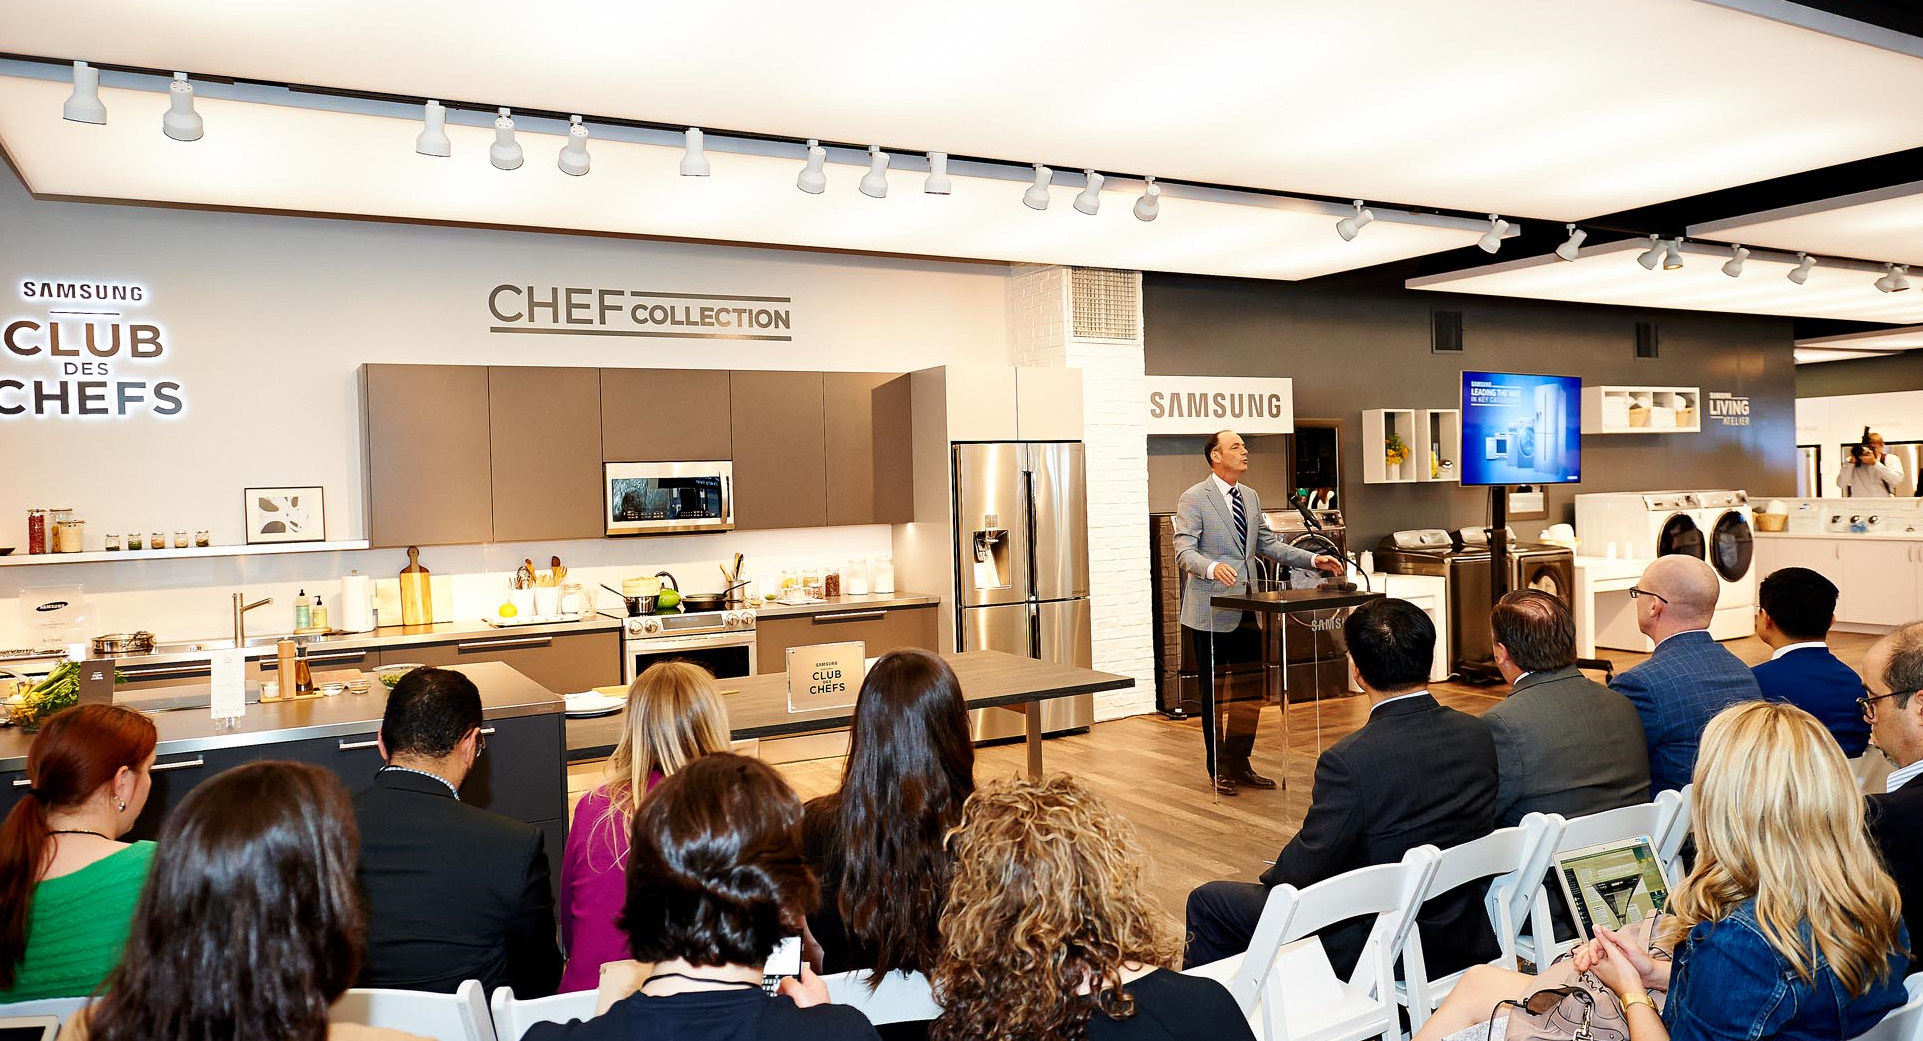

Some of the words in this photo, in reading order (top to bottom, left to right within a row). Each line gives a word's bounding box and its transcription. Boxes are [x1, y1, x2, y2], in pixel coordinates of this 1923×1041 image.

[23, 281, 143, 301] SAMSUNG
[488, 284, 625, 325] CHEF
[630, 303, 790, 330] COLLECTION
[4, 320, 164, 358] CLUB
[64, 362, 109, 375] DES
[0, 379, 183, 415] CHEFS
[1471, 388, 1496, 396] LEADING
[1150, 391, 1281, 418] SAMSUNG
[1710, 400, 1750, 416] LIVING
[1723, 416, 1751, 426] ATELIER
[812, 670, 841, 680] CLUB
[809, 683, 845, 694] CHEFS
